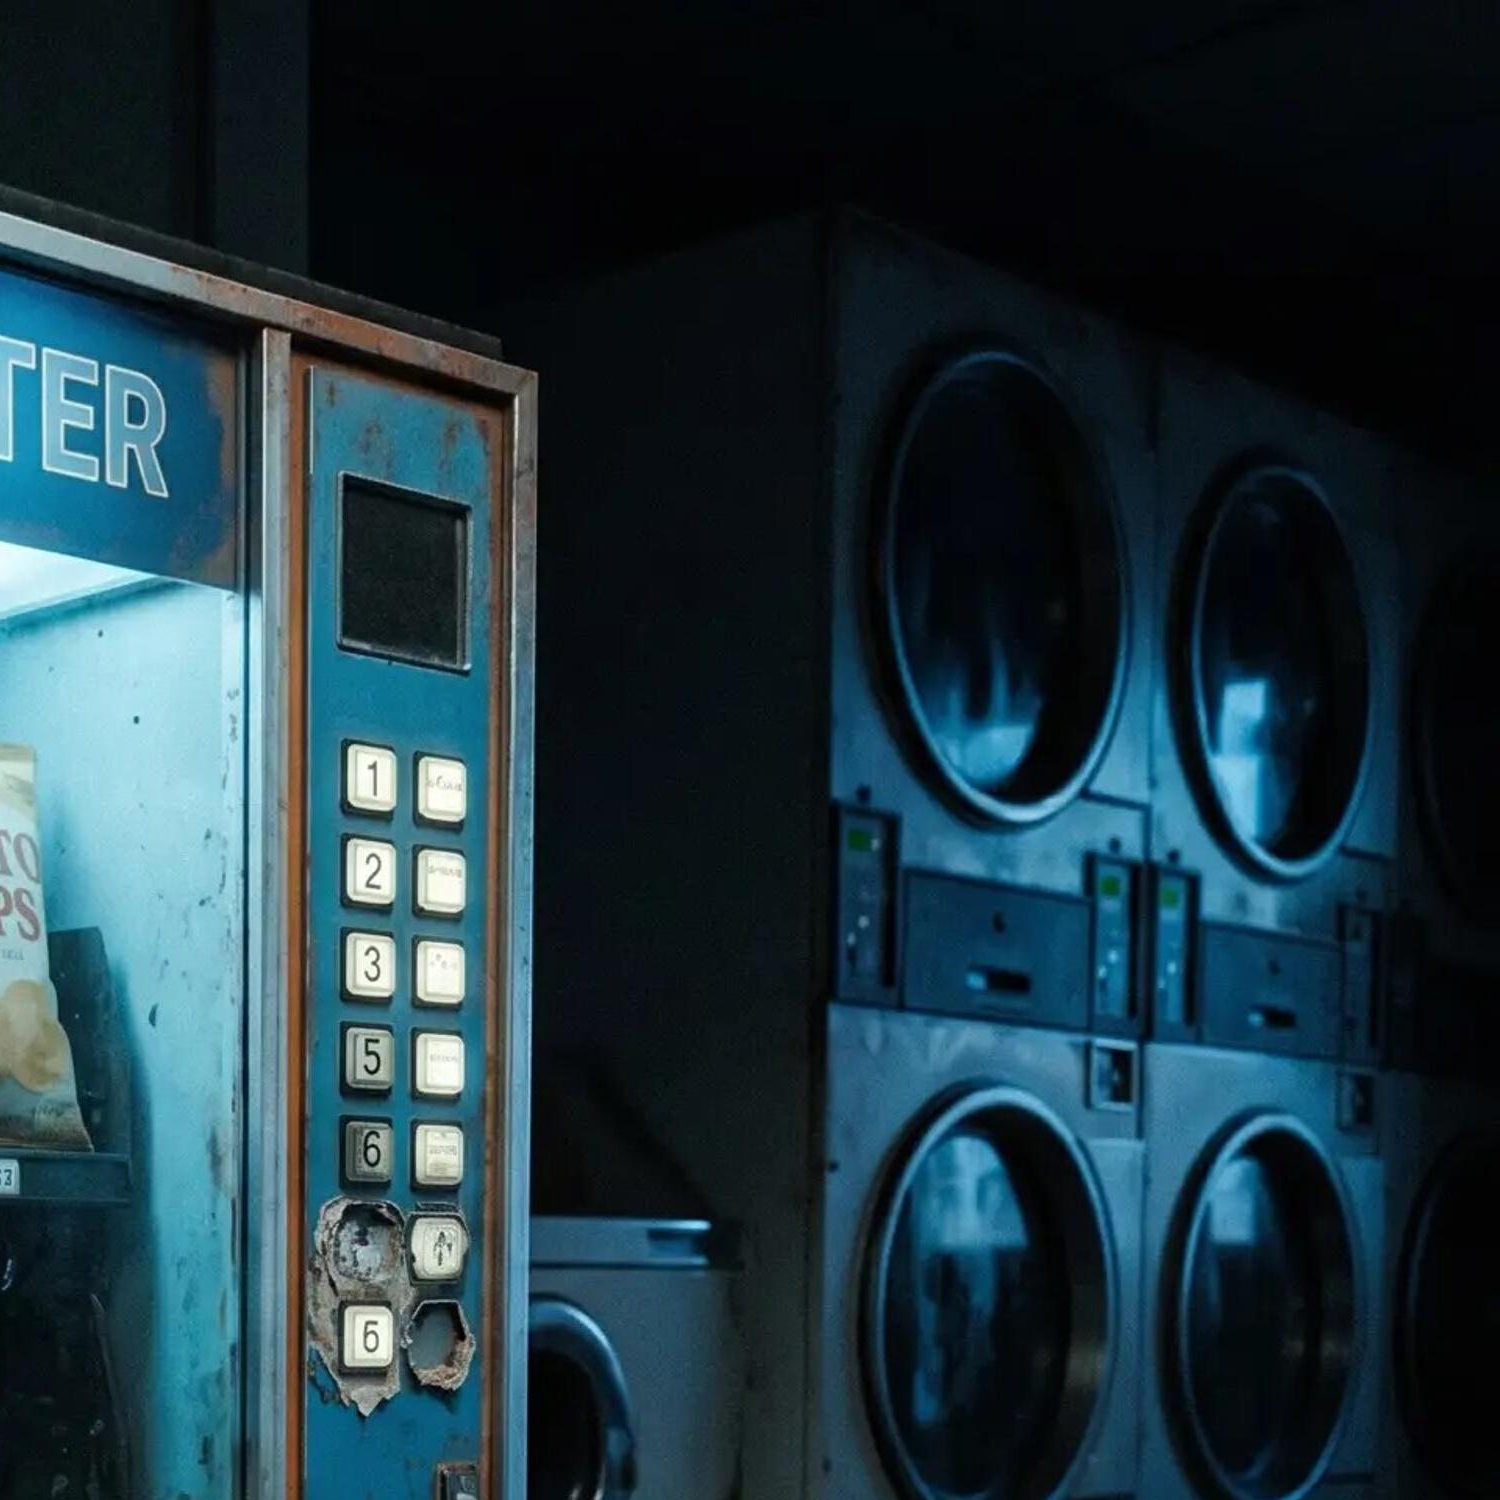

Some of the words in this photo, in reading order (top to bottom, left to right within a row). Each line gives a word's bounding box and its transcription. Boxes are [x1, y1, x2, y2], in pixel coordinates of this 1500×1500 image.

[366, 760, 378, 797] 1
[363, 852, 383, 891] 2
[363, 945, 382, 982] 3
[362, 1037, 382, 1077] 5
[361, 1130, 382, 1168] 6
[361, 1319, 380, 1353] 6
